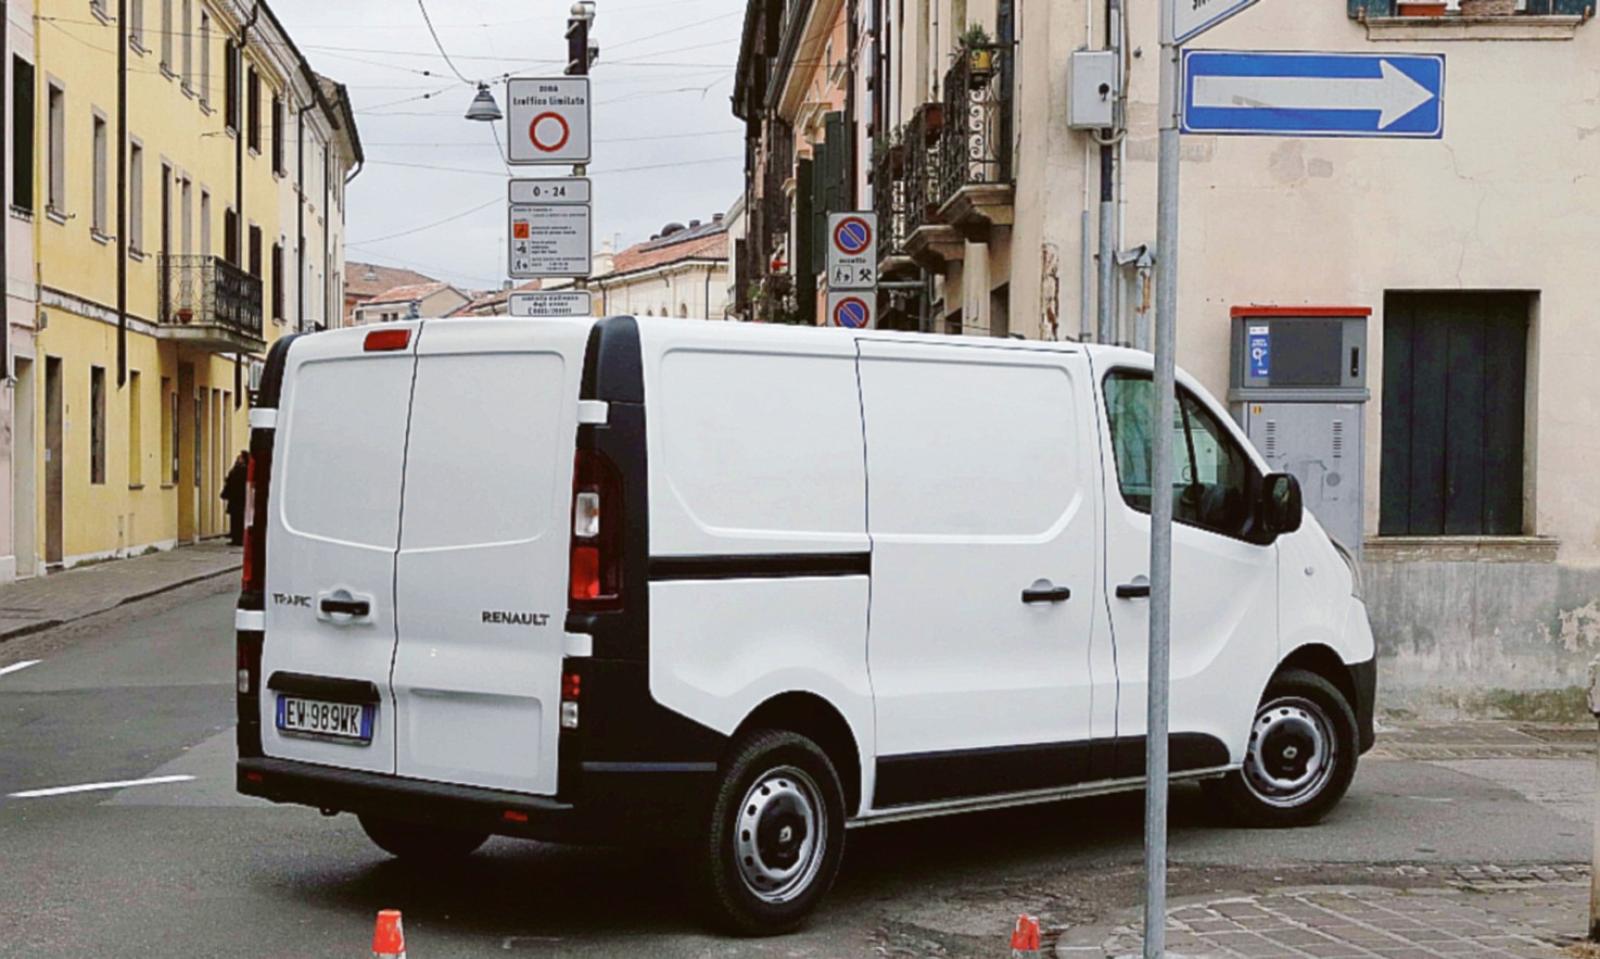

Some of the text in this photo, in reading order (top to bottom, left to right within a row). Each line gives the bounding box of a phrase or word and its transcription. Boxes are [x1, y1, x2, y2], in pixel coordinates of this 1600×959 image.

[533, 186, 541, 197] 0
[553, 186, 566, 197] 24
[482, 611, 550, 626] RENAULT
